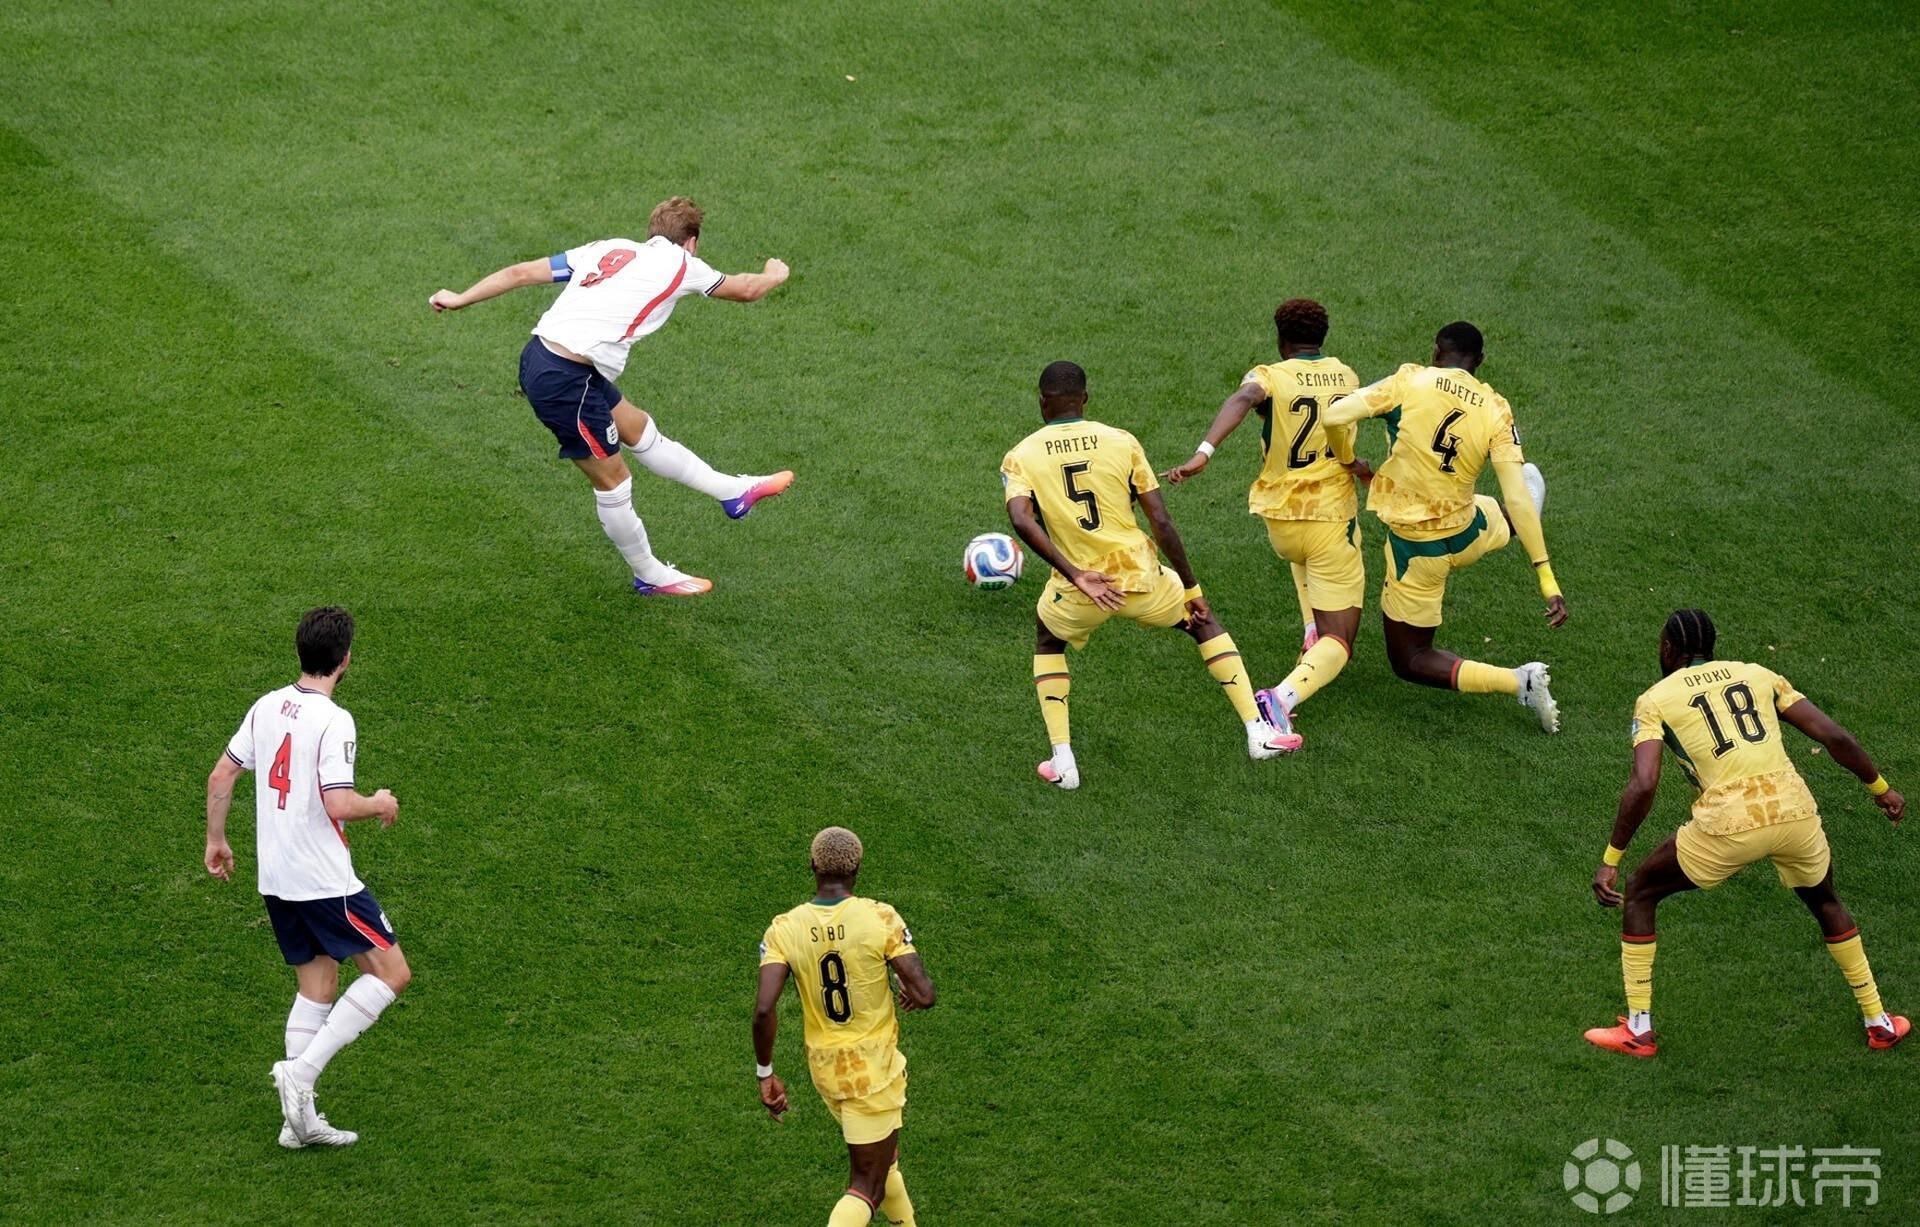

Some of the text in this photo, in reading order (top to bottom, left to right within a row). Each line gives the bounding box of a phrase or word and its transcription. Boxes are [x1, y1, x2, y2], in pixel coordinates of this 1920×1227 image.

[579, 249, 637, 288] 9
[1296, 372, 1346, 389] SENAYA
[1045, 434, 1099, 456] PARTEY
[1431, 407, 1468, 476] 4
[1061, 460, 1105, 533] 5
[1684, 668, 1732, 687] OPOKU
[280, 700, 302, 720] RICE
[1687, 679, 1770, 760] 18
[268, 731, 292, 811] 4
[809, 924, 846, 943] SIBO
[817, 950, 855, 1026] 8
